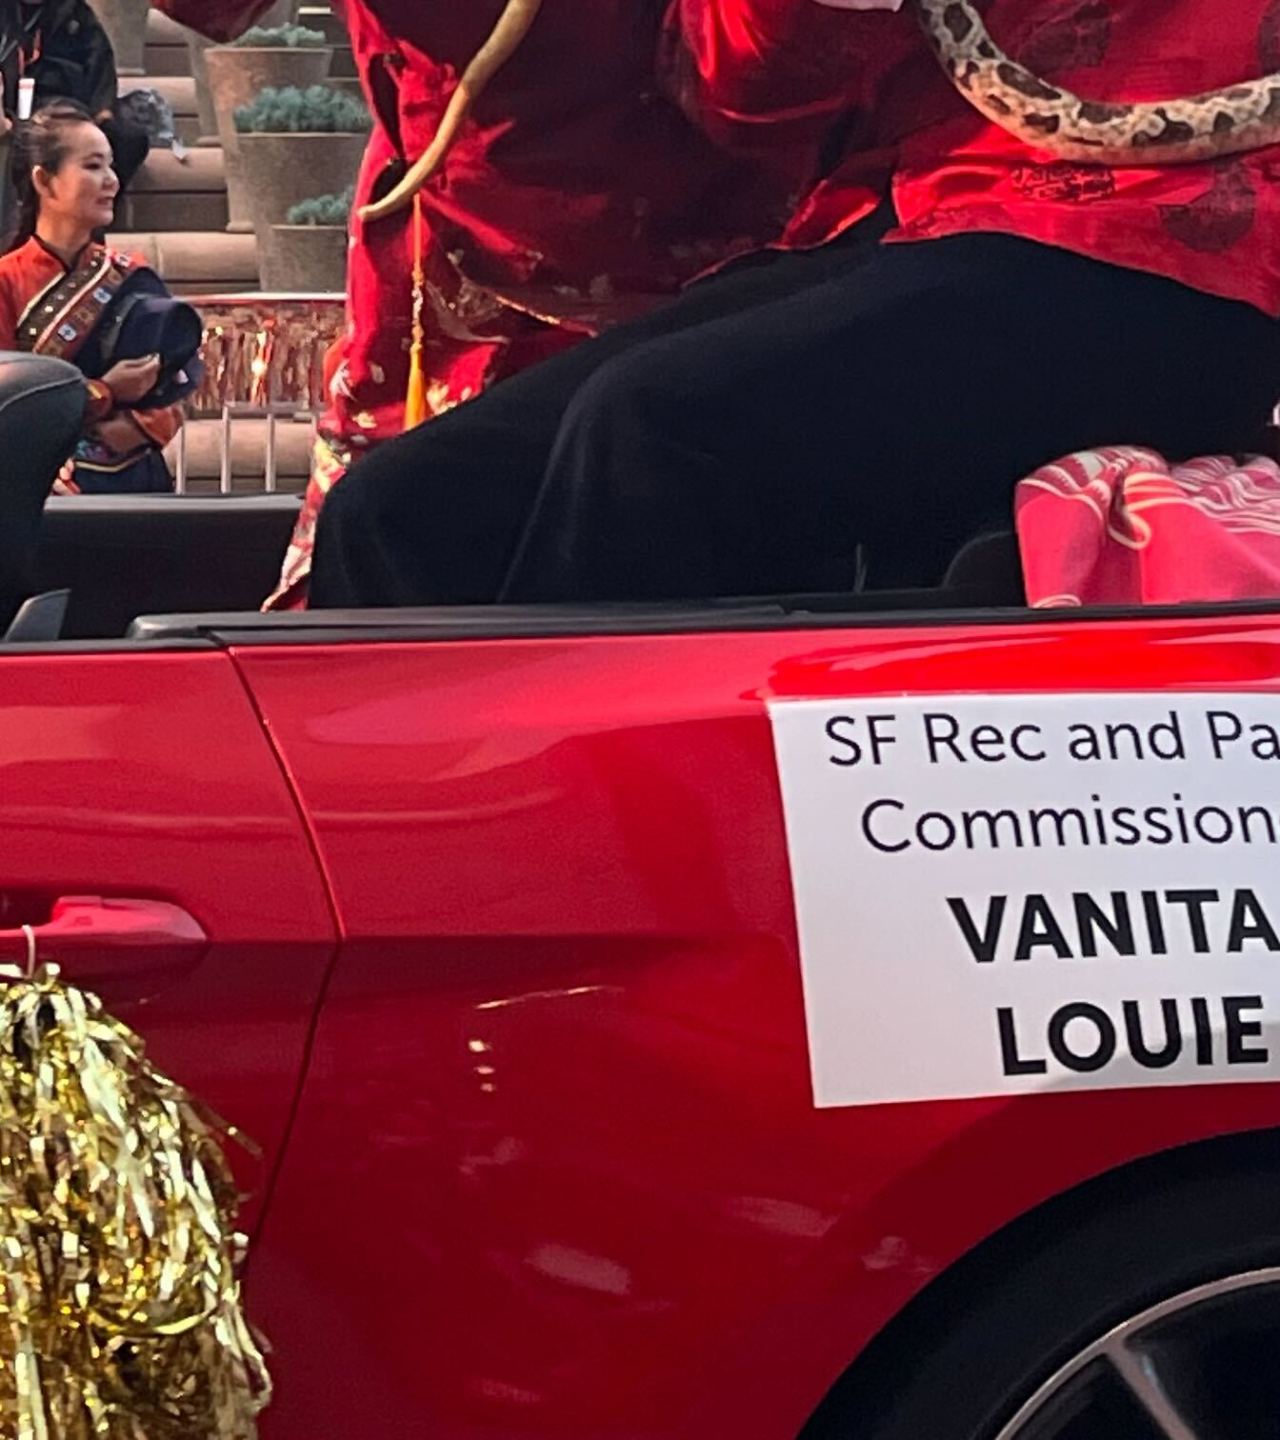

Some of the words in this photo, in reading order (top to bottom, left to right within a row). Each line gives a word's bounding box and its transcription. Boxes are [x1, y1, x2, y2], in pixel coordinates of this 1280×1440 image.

[825, 715, 897, 766] SF
[922, 712, 1047, 764] Rec
[1067, 710, 1186, 761] and
[996, 995, 1270, 1077] LOUIE
